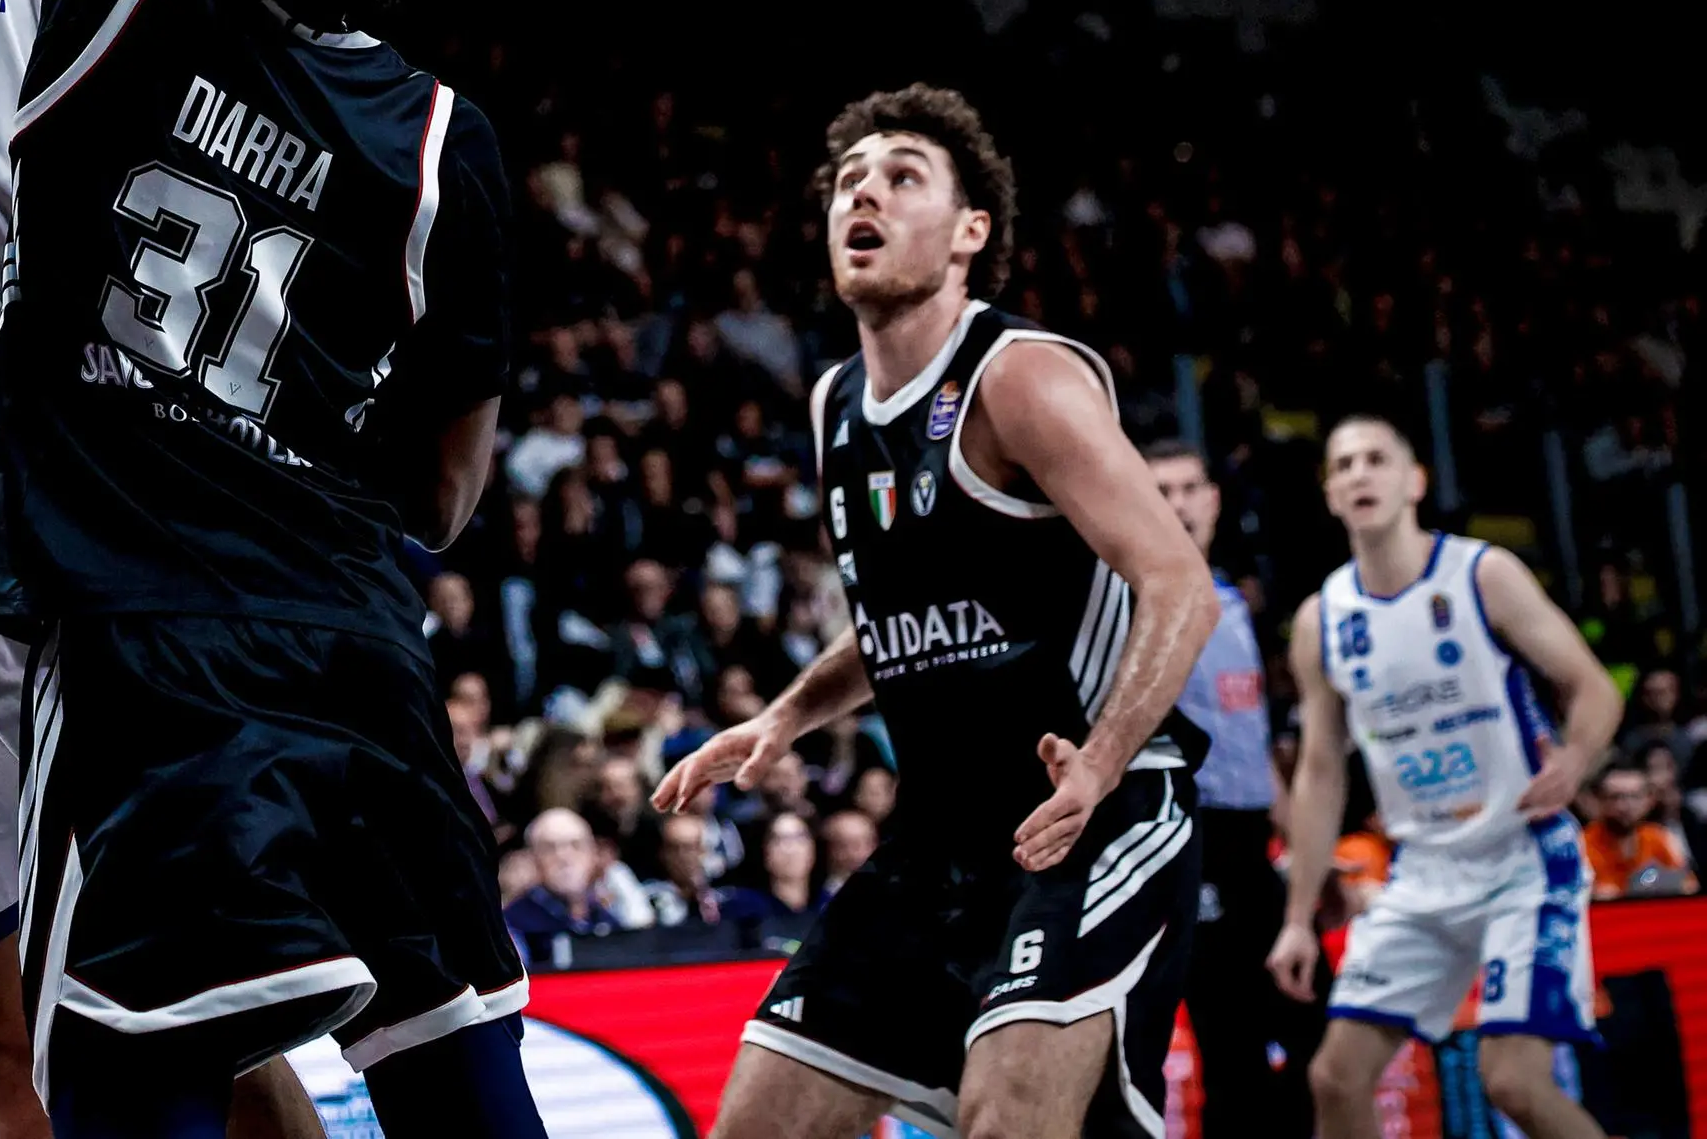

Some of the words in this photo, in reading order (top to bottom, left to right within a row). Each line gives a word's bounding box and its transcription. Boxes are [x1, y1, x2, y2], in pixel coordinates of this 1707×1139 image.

[172, 74, 334, 212] DIARRA
[98, 159, 315, 425] 31
[1008, 928, 1045, 974] 6
